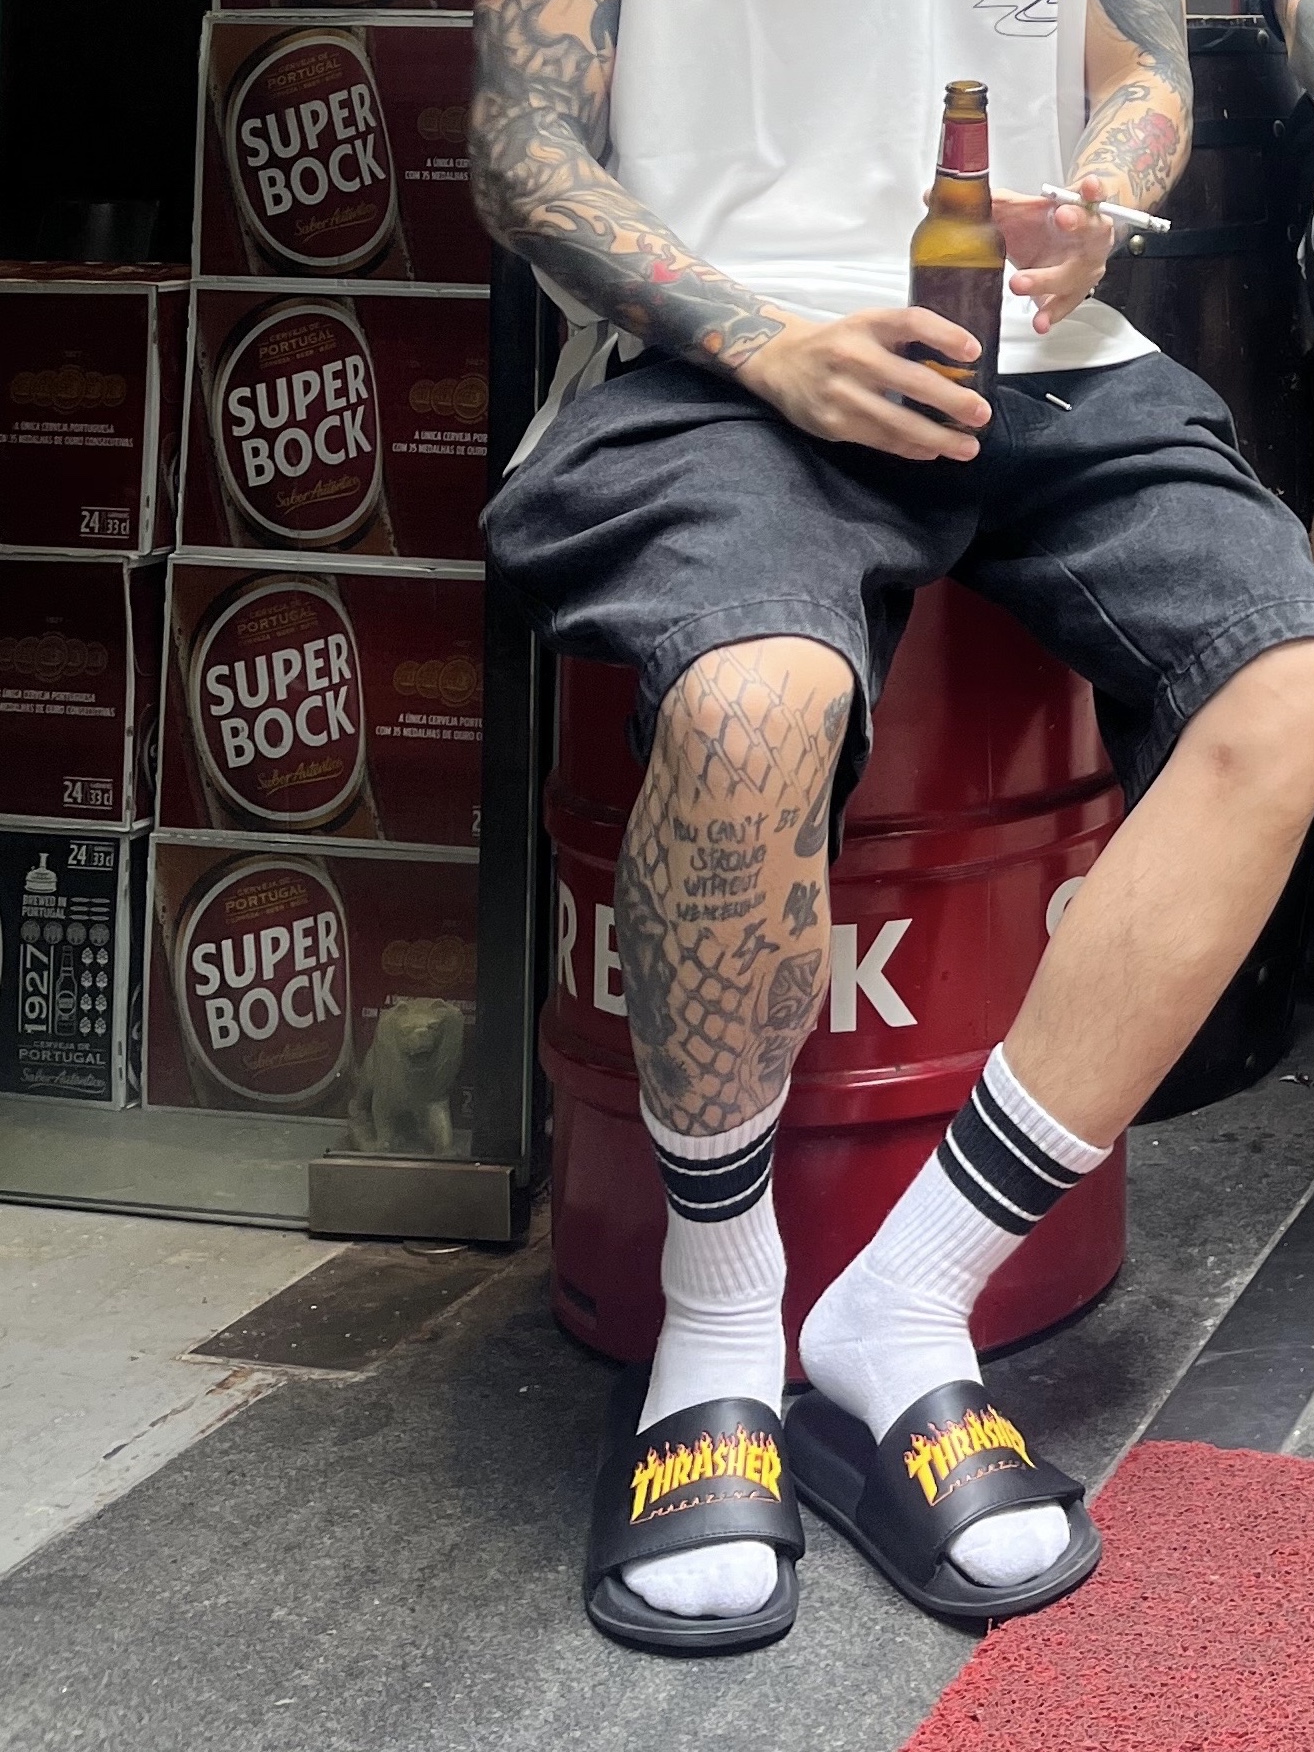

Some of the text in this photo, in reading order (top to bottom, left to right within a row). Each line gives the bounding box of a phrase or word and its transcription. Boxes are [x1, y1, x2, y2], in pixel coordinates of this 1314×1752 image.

[267, 57, 342, 90] PORTUGAL
[240, 82, 377, 167] SUPER
[257, 133, 387, 217] BOCK
[258, 328, 335, 359] PORTUGAL
[227, 354, 369, 437] SUPER
[241, 404, 373, 488] BOCK
[80, 510, 100, 533] 24
[237, 605, 317, 636] PORTUGAL
[205, 632, 352, 716] SUPER
[219, 685, 356, 769] BOCK
[63, 780, 83, 803] 24
[67, 844, 87, 865] 24
[224, 883, 307, 914] PORTUGAL
[23, 943, 49, 1035] 1927
[191, 910, 340, 996] SUPER
[205, 965, 342, 1051] BOCK
[18, 1048, 107, 1065] PORTUGAL
[630, 1423, 782, 1525] THRASHER
